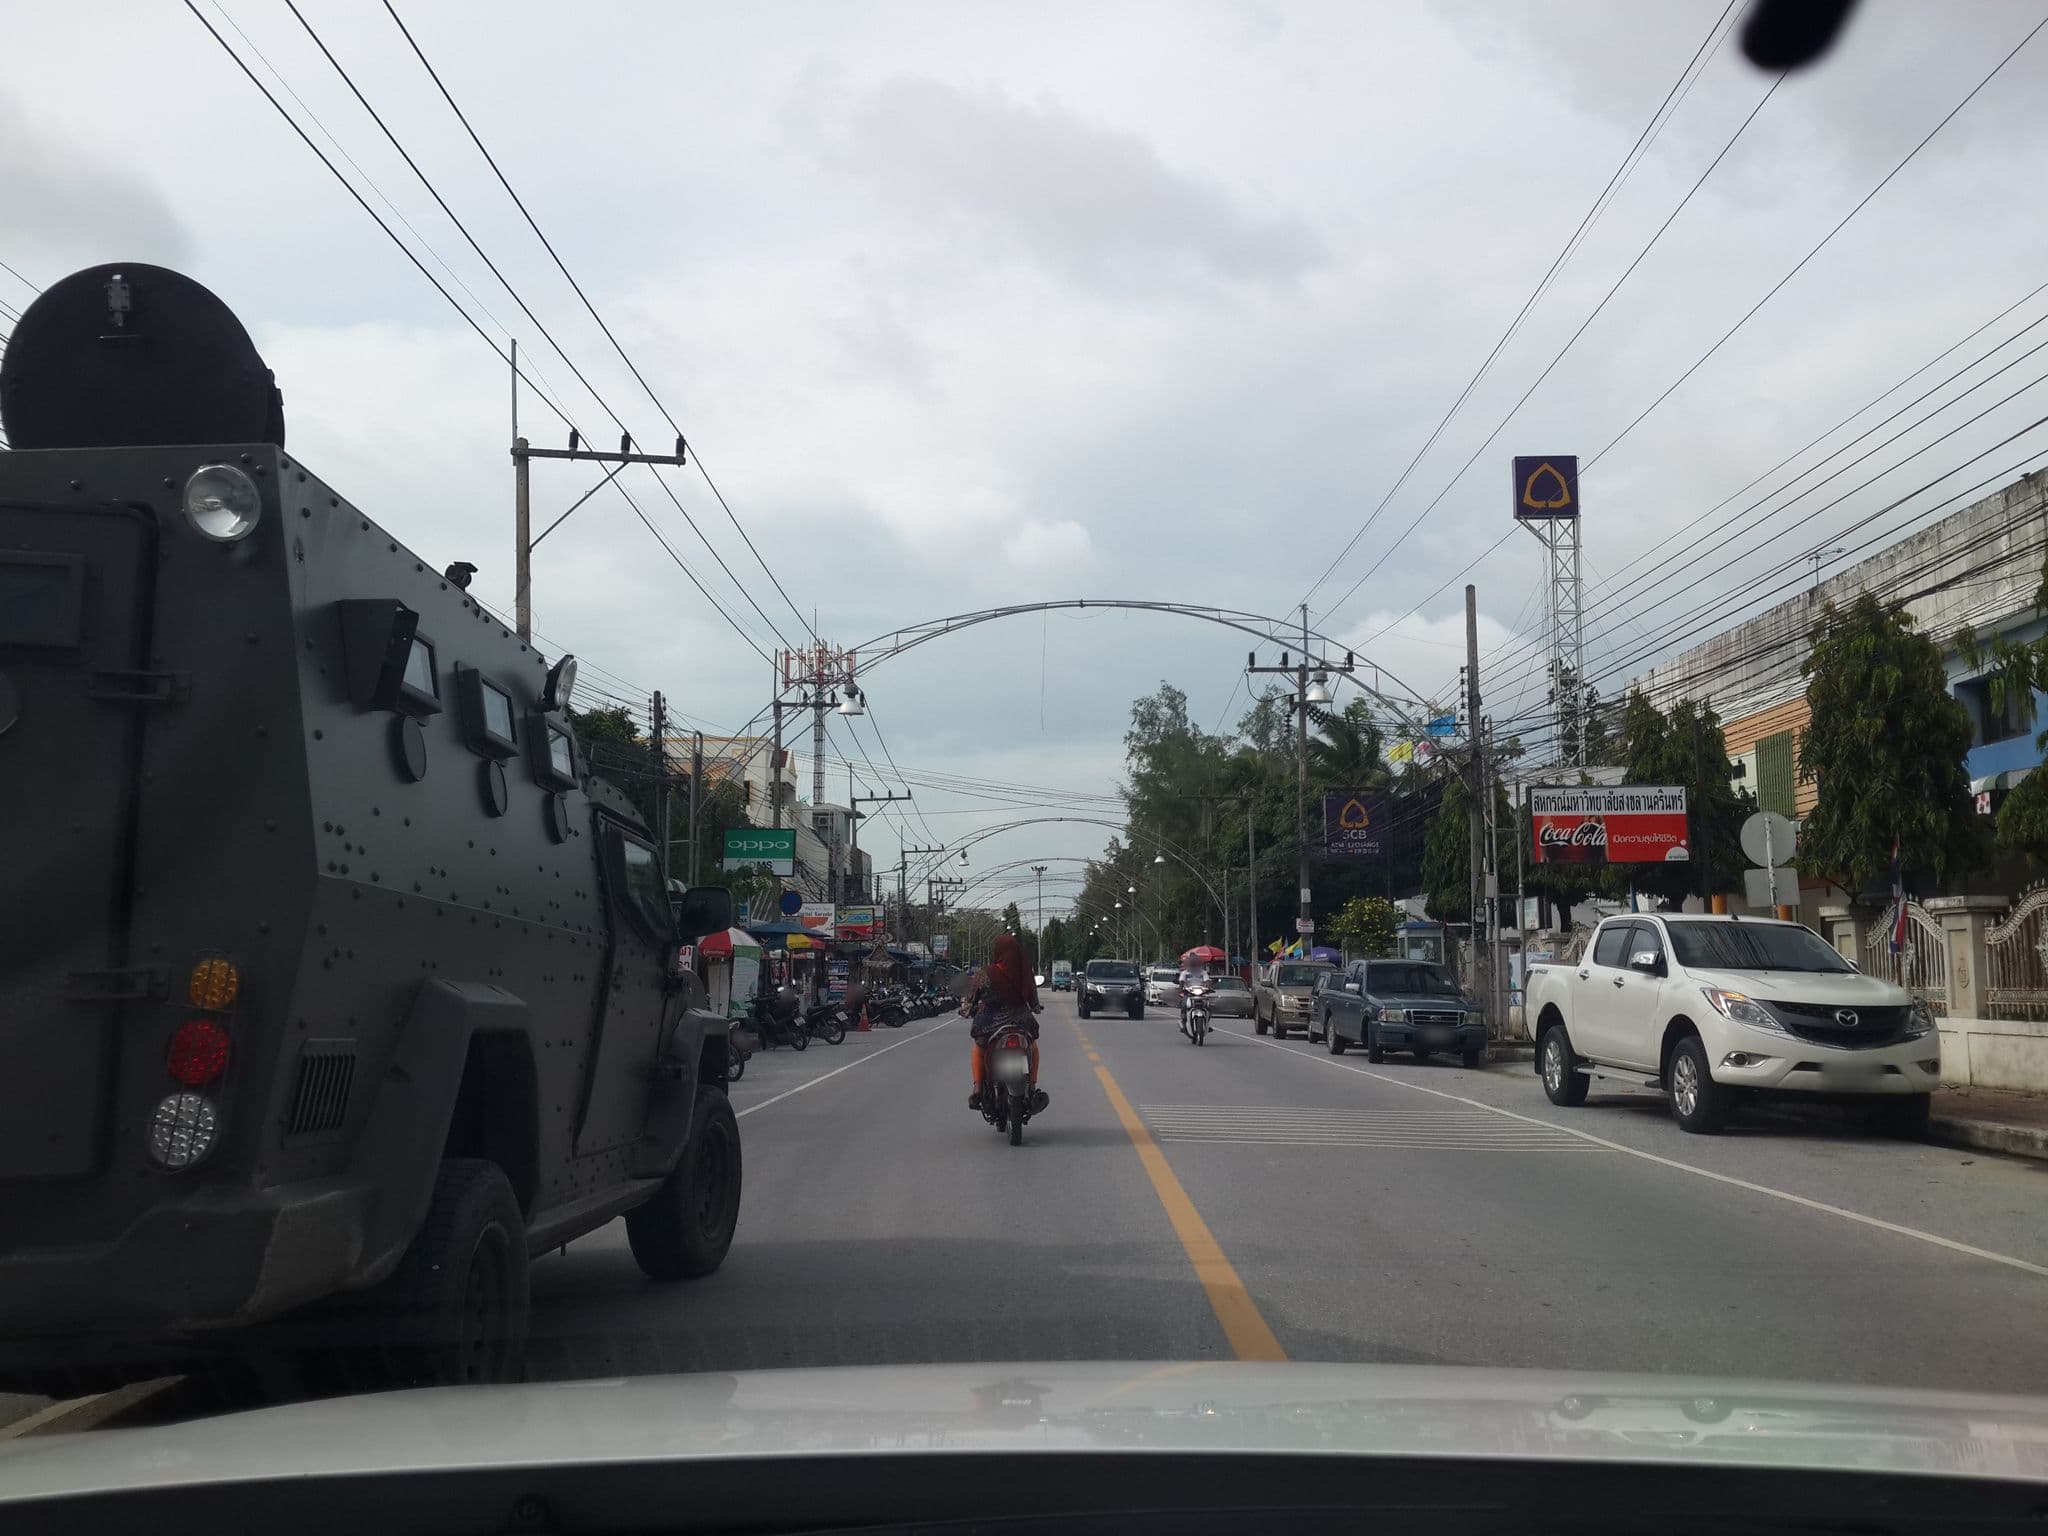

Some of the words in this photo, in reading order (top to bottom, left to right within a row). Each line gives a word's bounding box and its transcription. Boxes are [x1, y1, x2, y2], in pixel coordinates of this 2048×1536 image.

[1534, 788, 1684, 812] สหกรณ์มหาวิทยาลัยสงขลานครินทร์
[1342, 829, 1367, 840] SCB
[1539, 822, 1608, 847] Coca-Cola
